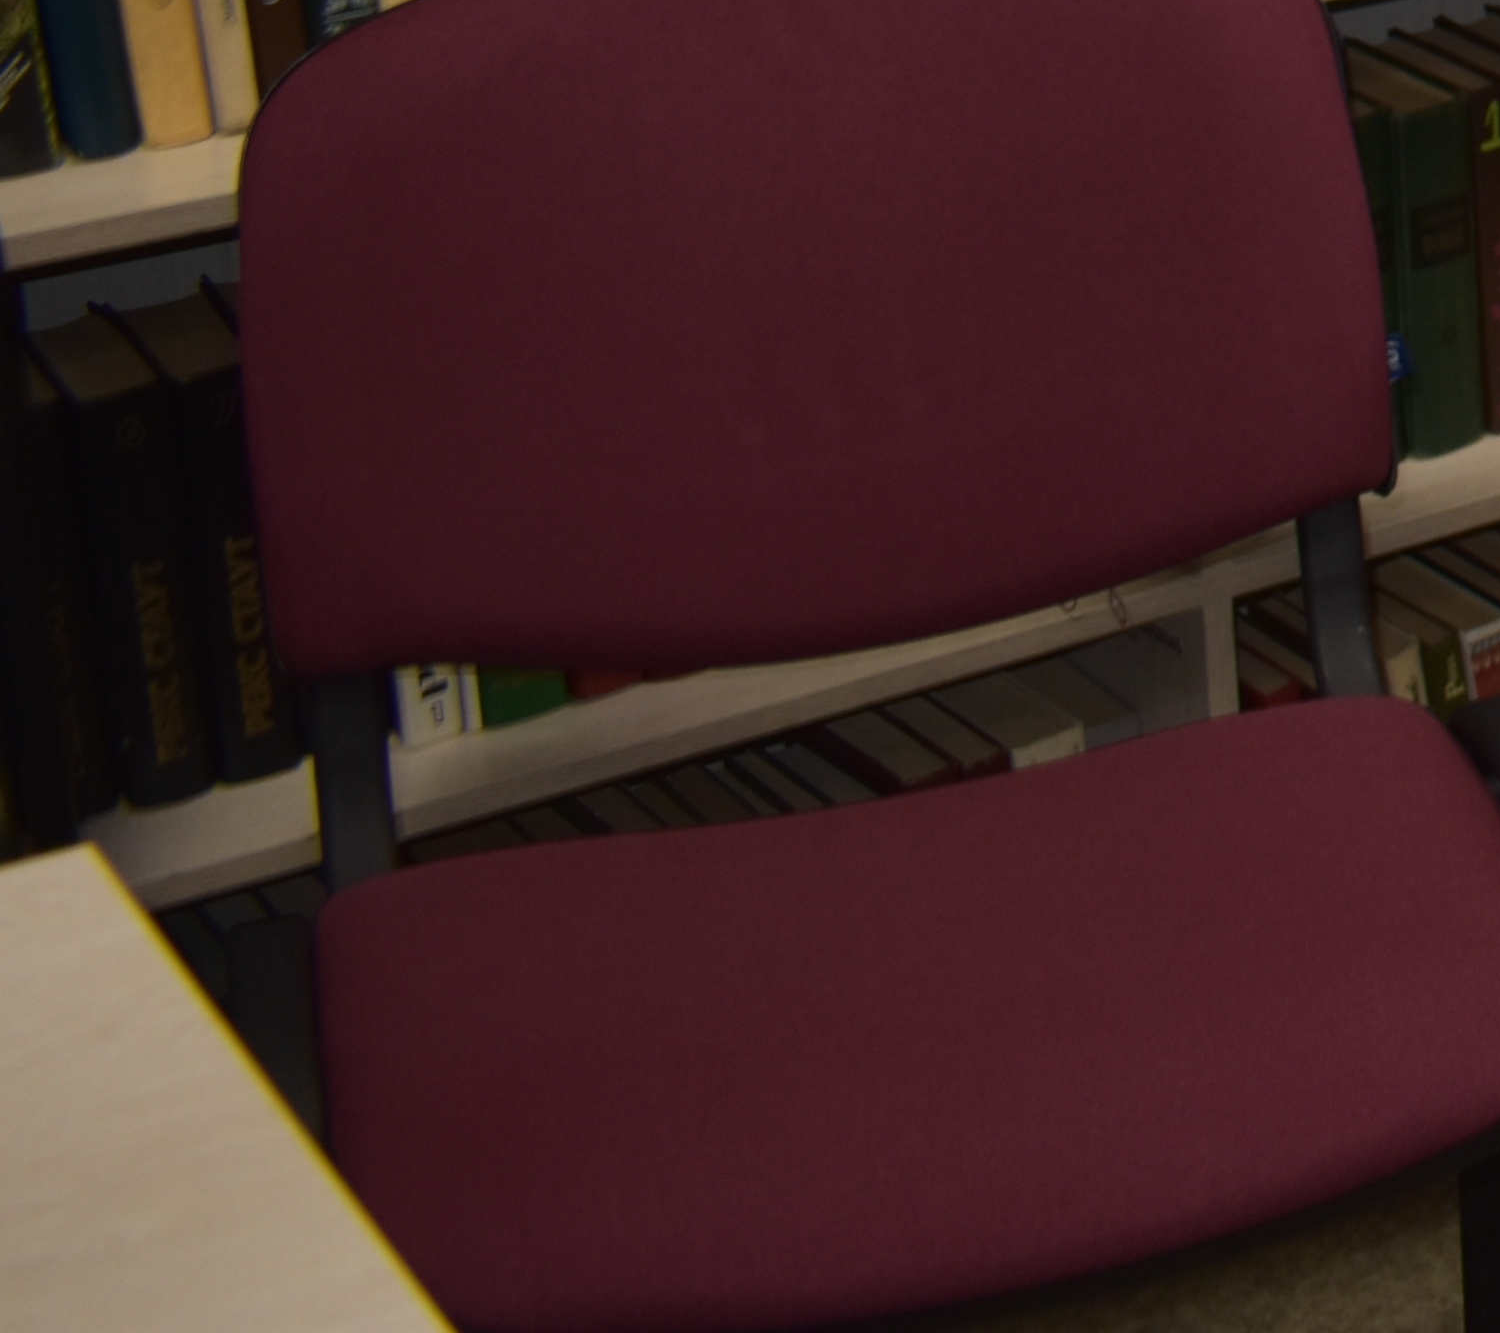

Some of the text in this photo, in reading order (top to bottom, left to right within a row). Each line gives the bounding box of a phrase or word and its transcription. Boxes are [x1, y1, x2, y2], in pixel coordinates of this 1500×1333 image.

[131, 558, 188, 767] РЕКС СТАУТ
[224, 534, 276, 739] РЕКС СТАУТ
